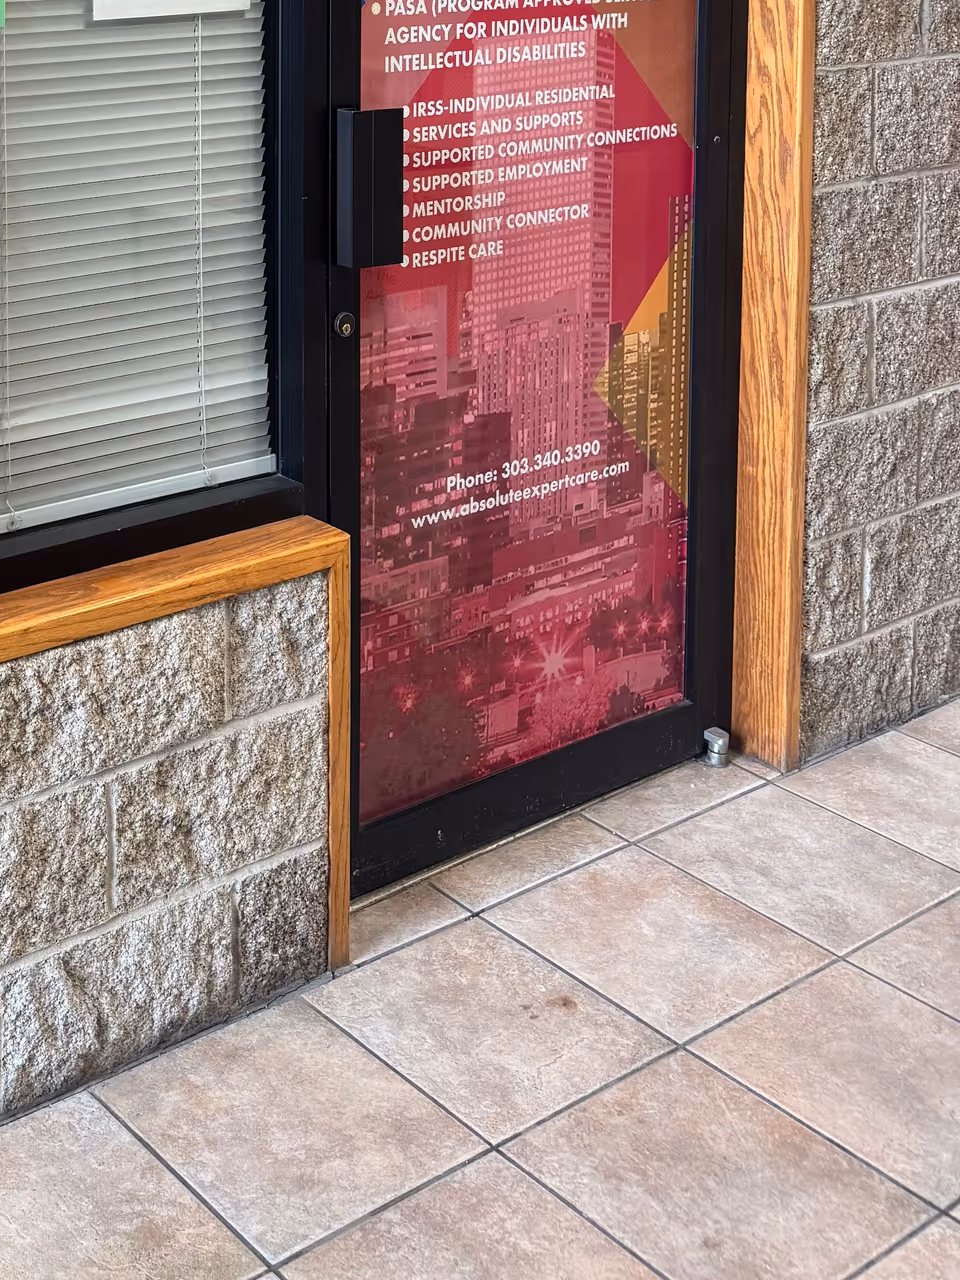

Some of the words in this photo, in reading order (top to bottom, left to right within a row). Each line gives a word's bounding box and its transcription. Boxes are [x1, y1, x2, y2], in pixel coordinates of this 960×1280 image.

[384, 24, 452, 46] AGENCY
[455, 21, 487, 41] FOR
[491, 14, 588, 38] INDIVIDUALS
[590, 12, 628, 31] WITH
[384, 48, 493, 74] INTELLECTUAL
[496, 40, 587, 64] DISABILITIES
[412, 91, 533, 119] IRSS-INDIVIDUAL
[535, 84, 616, 106] RESIDENTIAL
[412, 121, 477, 143] SERVICES
[479, 117, 512, 136] AND
[515, 110, 584, 133] SUPPORTS
[412, 144, 495, 169] SUPPORTED
[498, 133, 586, 158] COMMUNITY
[586, 122, 678, 148] CONNECTIONS
[412, 168, 495, 193] SUPPORTED
[498, 157, 588, 183] EMPLOYMENT
[412, 191, 506, 218] MENTORSHIP
[411, 215, 504, 243] COMMUNITY
[506, 203, 590, 230] CONNECTOR
[412, 245, 465, 269] RESPITE
[468, 239, 504, 260] CARE
[446, 470, 498, 494] Phone:
[501, 439, 601, 480] 303.340.3390
[411, 460, 631, 529] www.absoluteexpertcare.com
